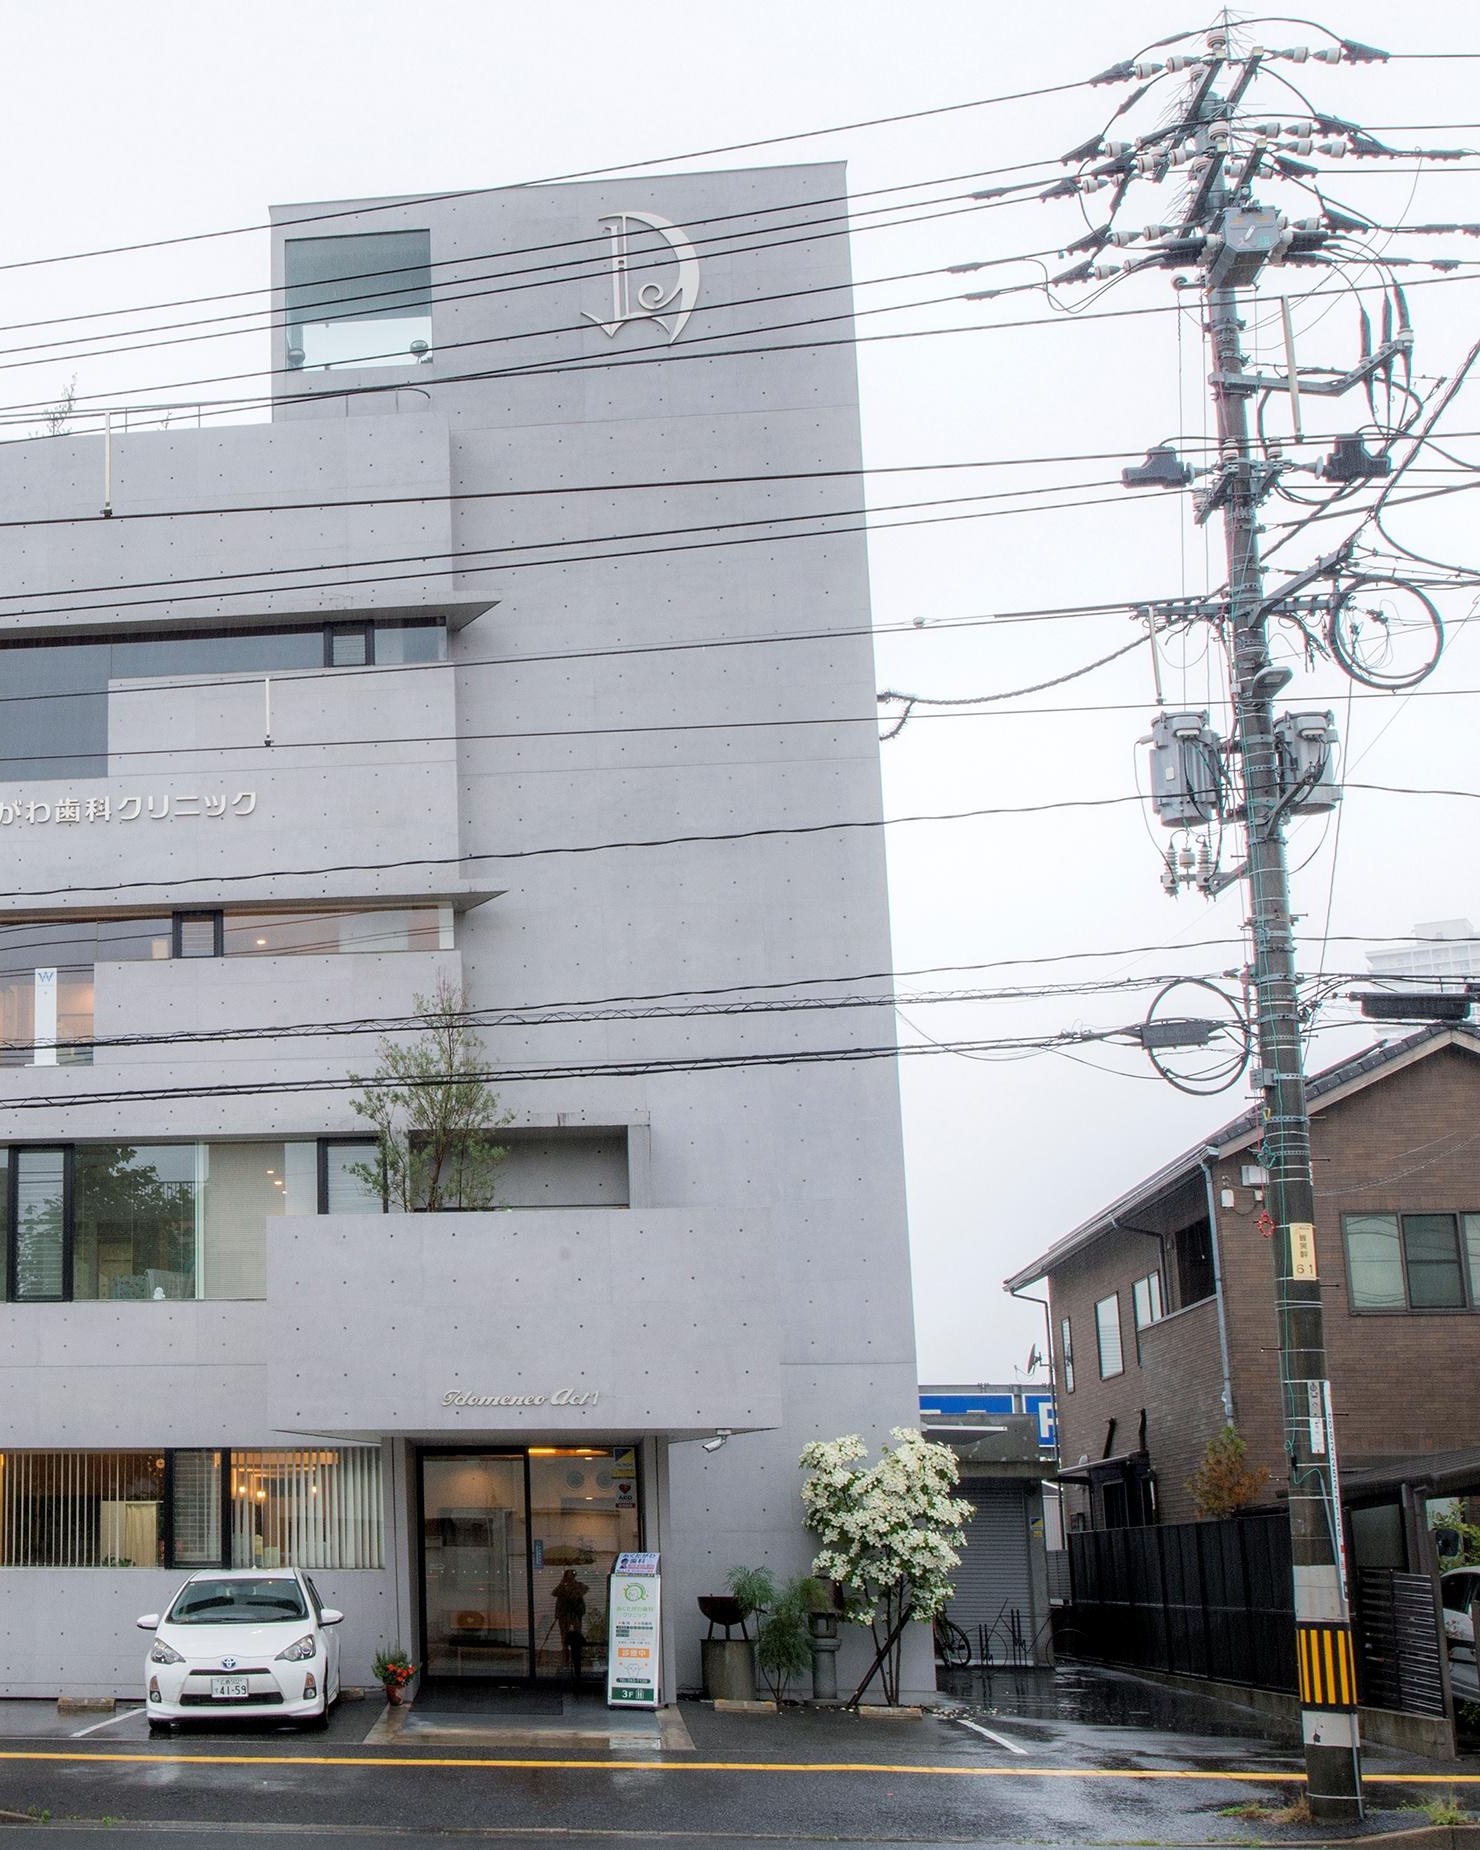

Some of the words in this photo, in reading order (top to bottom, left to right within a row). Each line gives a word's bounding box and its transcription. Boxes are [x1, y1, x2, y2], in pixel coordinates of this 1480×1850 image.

[441, 1389, 546, 1407] Idomeneo
[220, 1685, 247, 1695] 41-59
[621, 1690, 634, 1698] 3F
